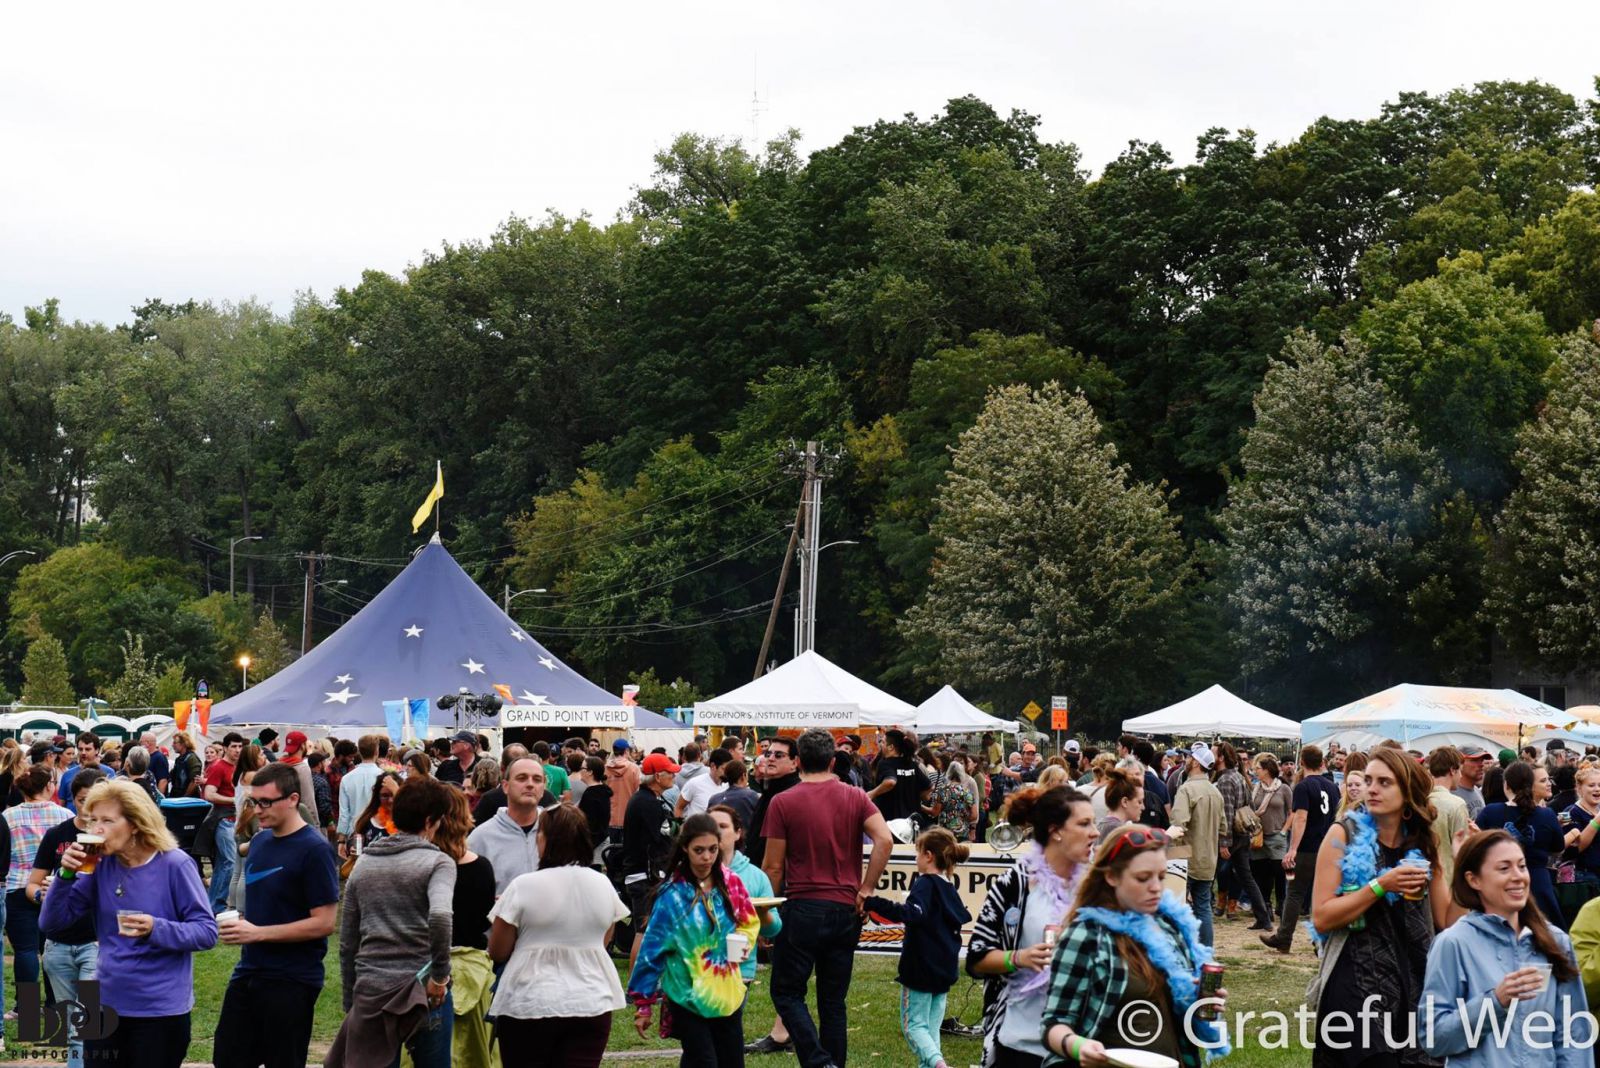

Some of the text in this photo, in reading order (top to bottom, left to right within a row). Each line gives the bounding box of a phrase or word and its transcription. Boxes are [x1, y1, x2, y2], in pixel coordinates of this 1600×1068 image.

[506, 710, 629, 722] GRAND POINT WEIRD
[699, 710, 853, 720] GOVERNOR'S INSTITUTE OF VERMONT
[1320, 790, 1330, 815] 3
